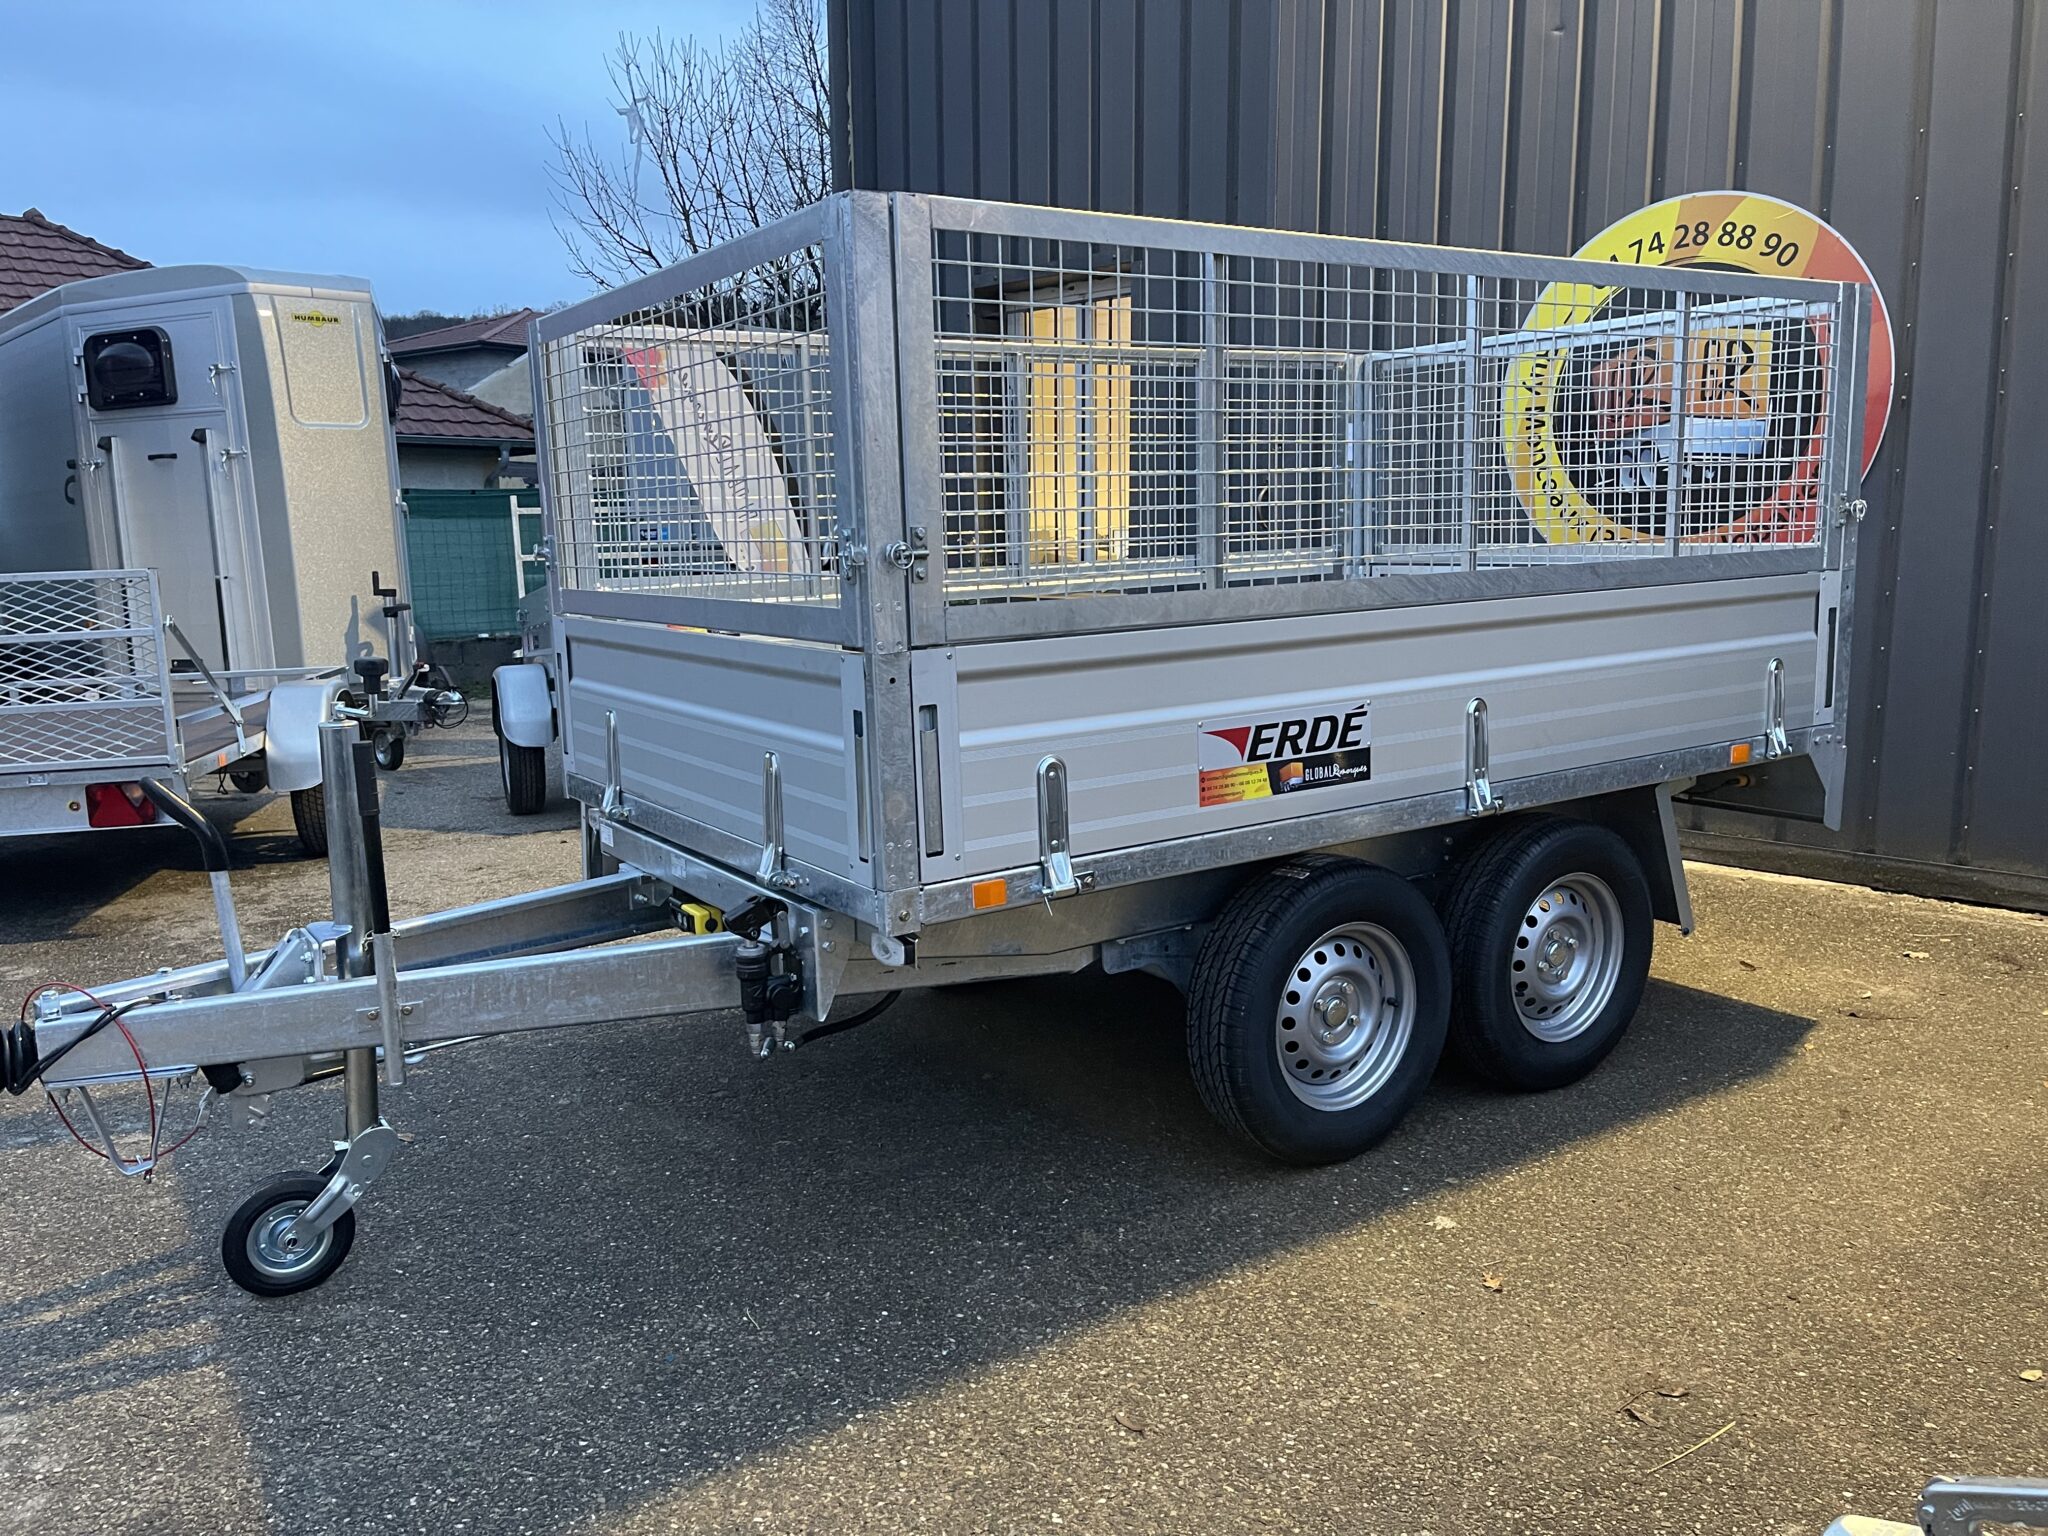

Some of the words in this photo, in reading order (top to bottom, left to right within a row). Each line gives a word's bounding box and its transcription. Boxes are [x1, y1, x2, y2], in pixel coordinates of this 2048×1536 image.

[1628, 231, 1665, 264] 74
[1674, 221, 1710, 250] 28
[1717, 221, 1757, 250] 88
[1759, 233, 1799, 267] 90
[294, 314, 339, 323] HUMBAUR
[1247, 704, 1367, 762] ERDÉ
